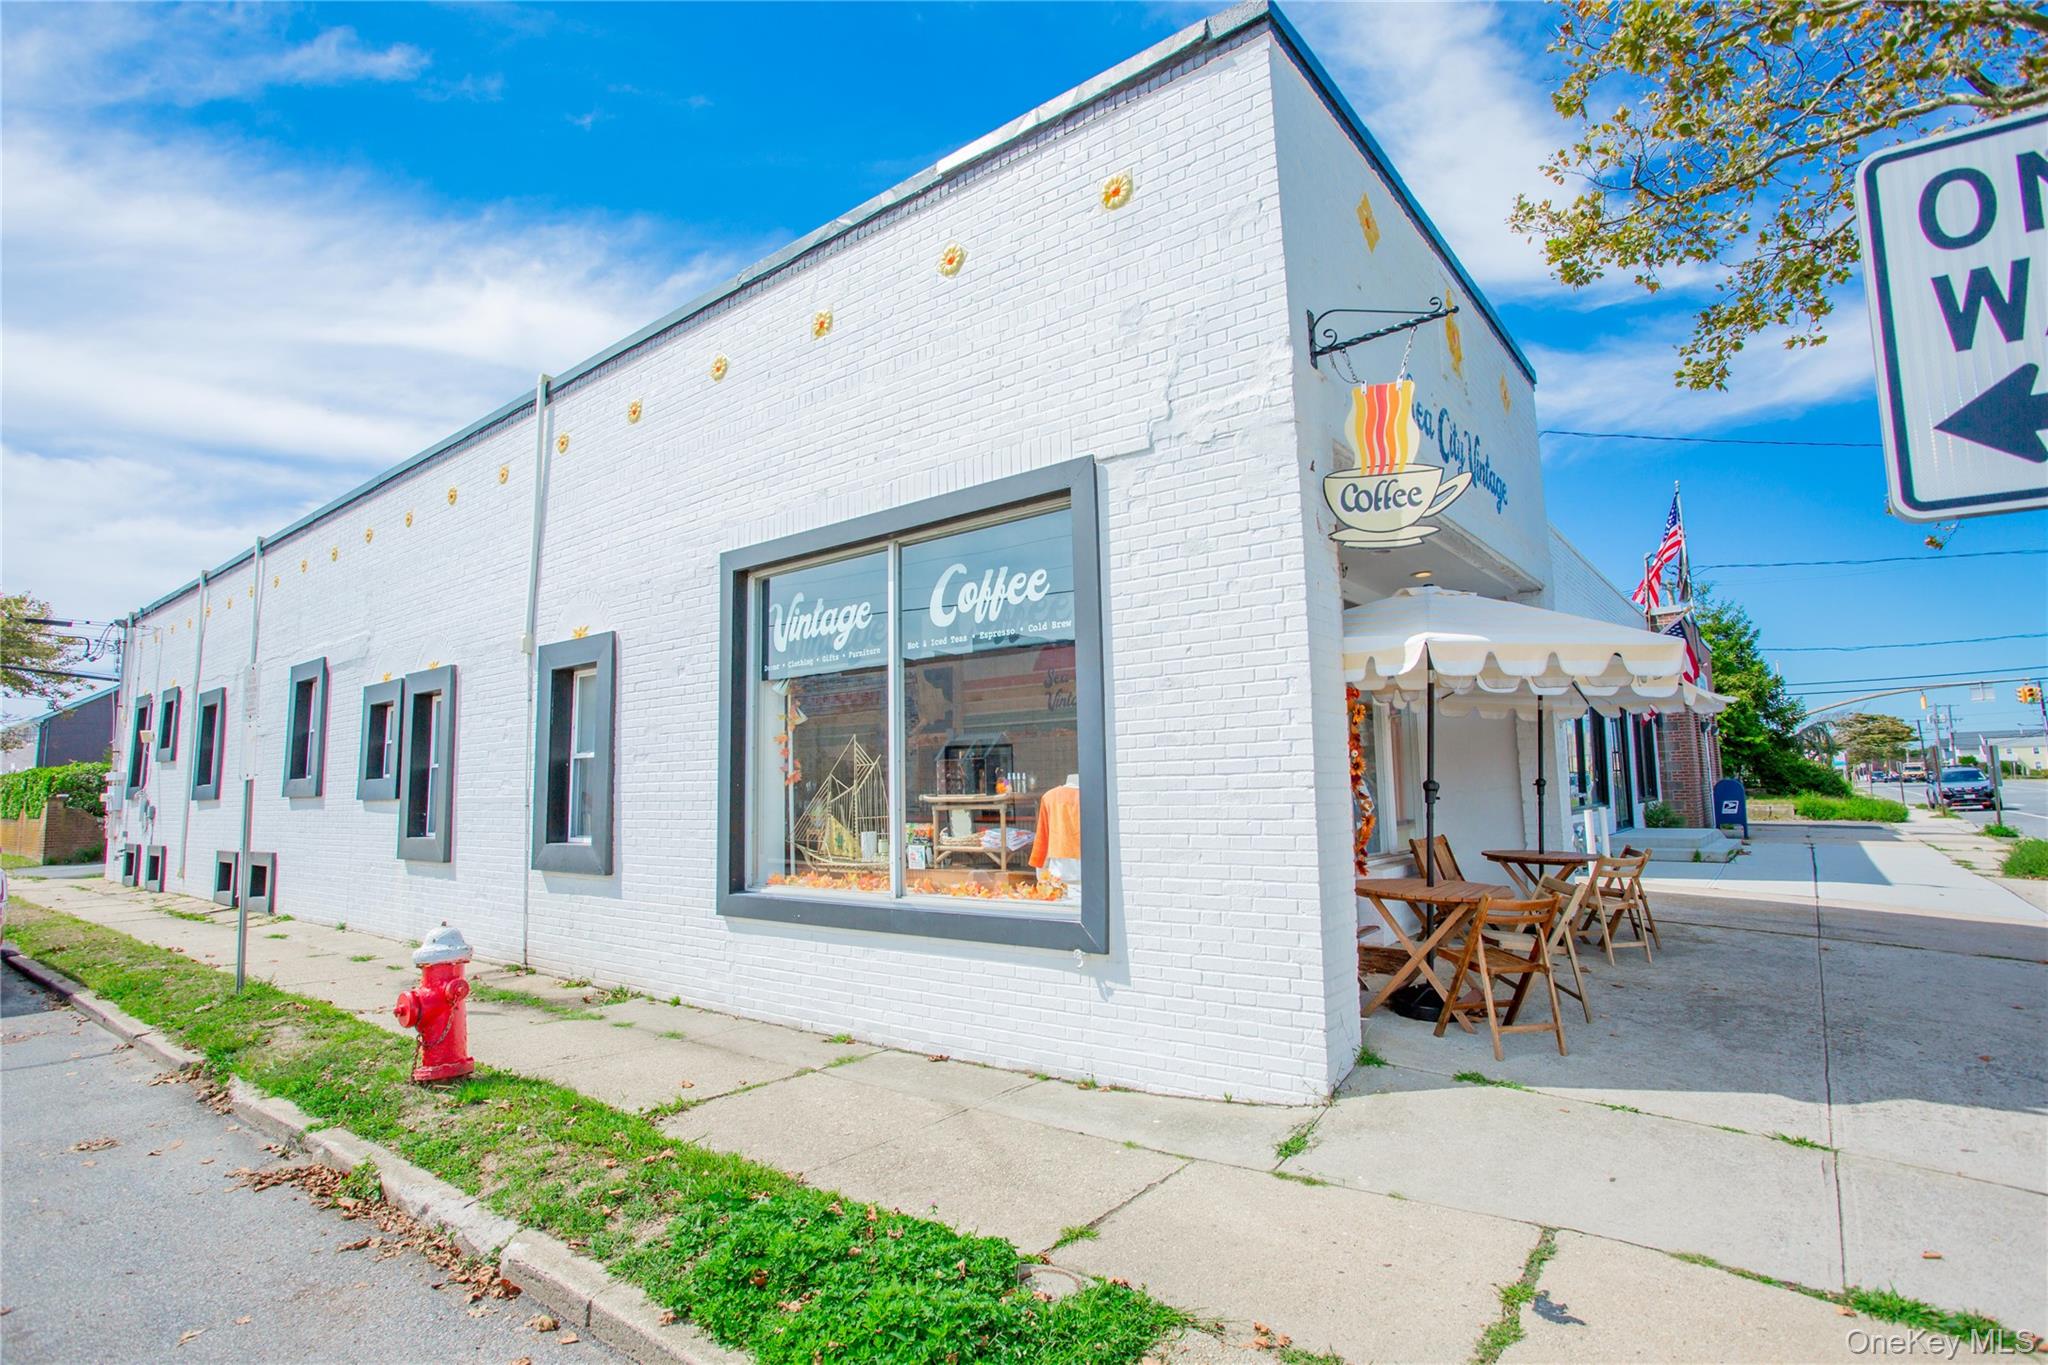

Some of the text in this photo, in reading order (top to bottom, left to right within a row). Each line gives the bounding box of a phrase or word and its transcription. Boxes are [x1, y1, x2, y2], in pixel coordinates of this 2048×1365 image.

[1931, 257, 2048, 353] W
[1438, 407, 1464, 475] City
[1464, 430, 1508, 515] Vintage
[1340, 479, 1424, 513] Coffee
[769, 592, 873, 653] Vintage
[929, 563, 1051, 628] Coffee
[930, 636, 947, 646] Iced
[950, 633, 967, 643] Teas
[979, 628, 1016, 641] Espresso
[1028, 621, 1048, 632] Cold
[1052, 619, 1072, 629] Brew
